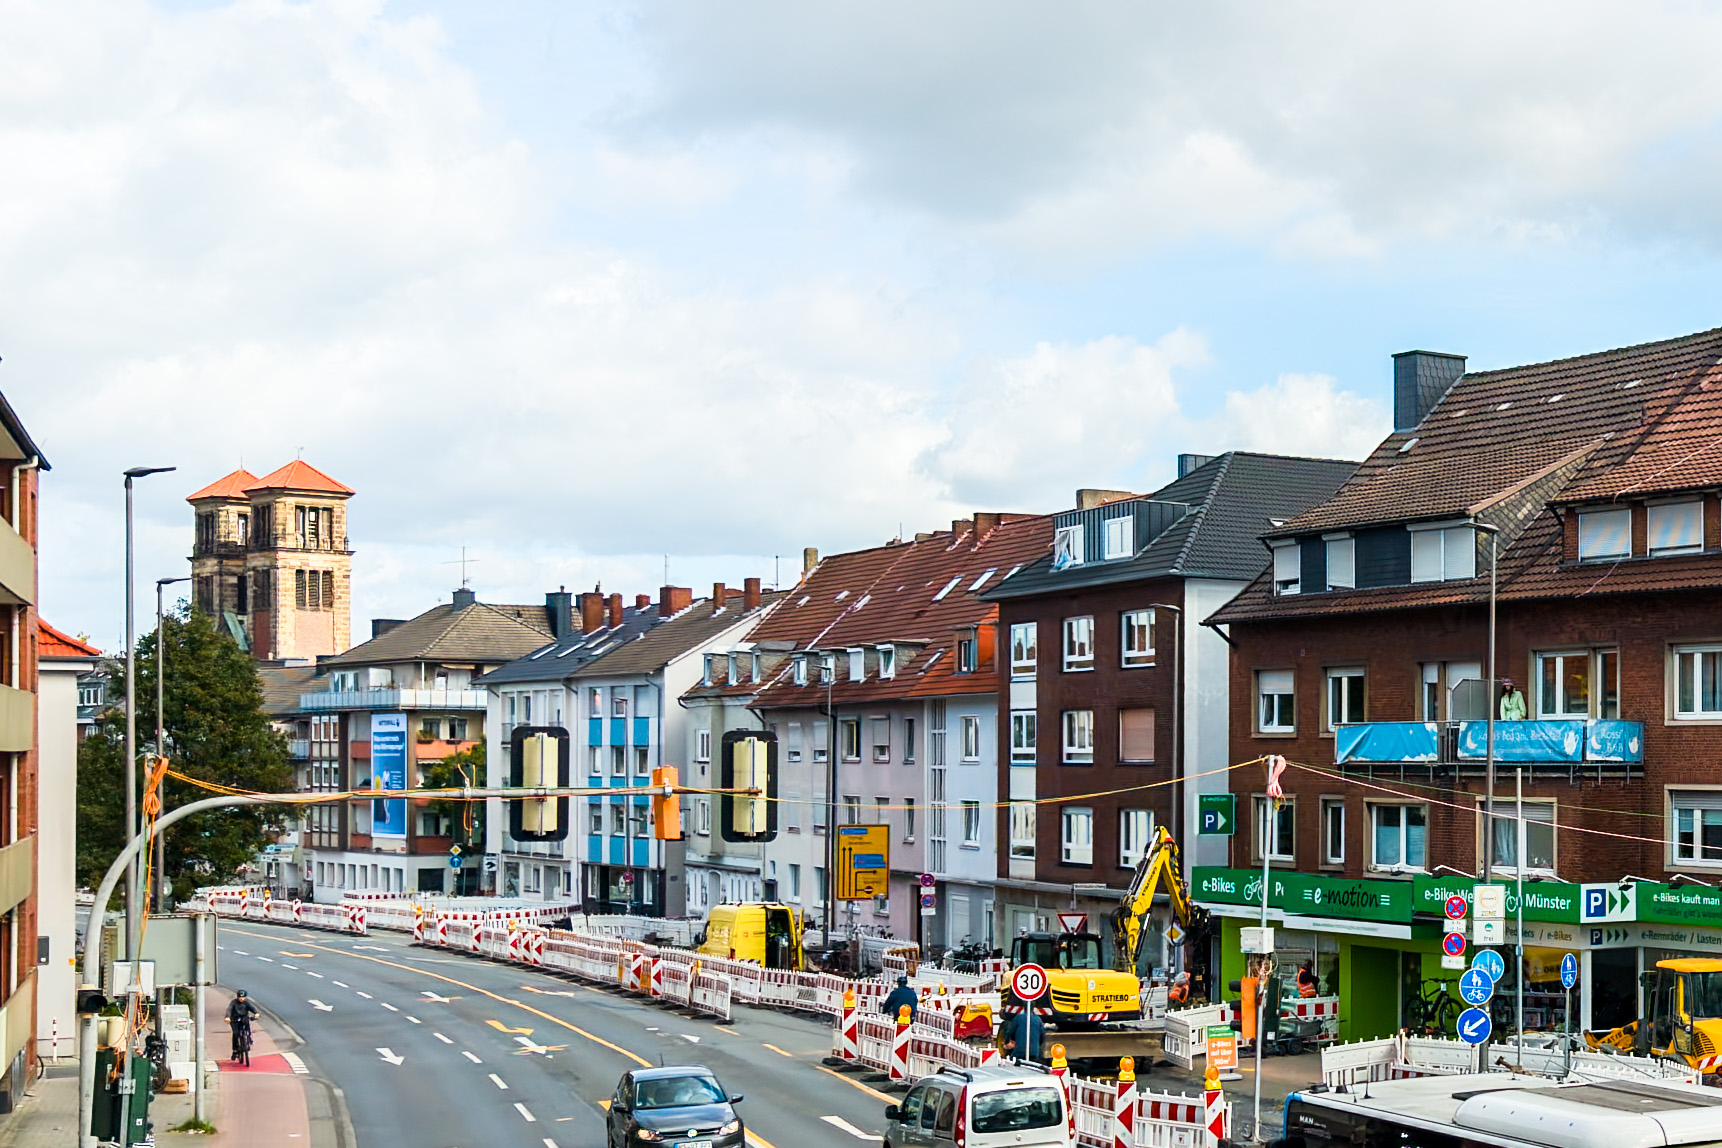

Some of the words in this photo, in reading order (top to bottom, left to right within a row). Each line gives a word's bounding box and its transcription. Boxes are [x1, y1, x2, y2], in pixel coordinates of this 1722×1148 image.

[1202, 876, 1236, 894] e-Bikes
[1314, 883, 1380, 909] e-motion
[1525, 893, 1572, 910] Münster
[1653, 892, 1680, 903] e-Bikes
[1681, 893, 1701, 905] kauft
[1702, 896, 1720, 906] man
[1547, 930, 1572, 941] e-Bikes
[1641, 930, 1687, 943] e-Rennräder
[1020, 973, 1040, 990] 30
[1092, 994, 1129, 1003] STRATIEBO
[1211, 1040, 1232, 1048] e-Bikes
[1299, 1115, 1314, 1125] MAN
